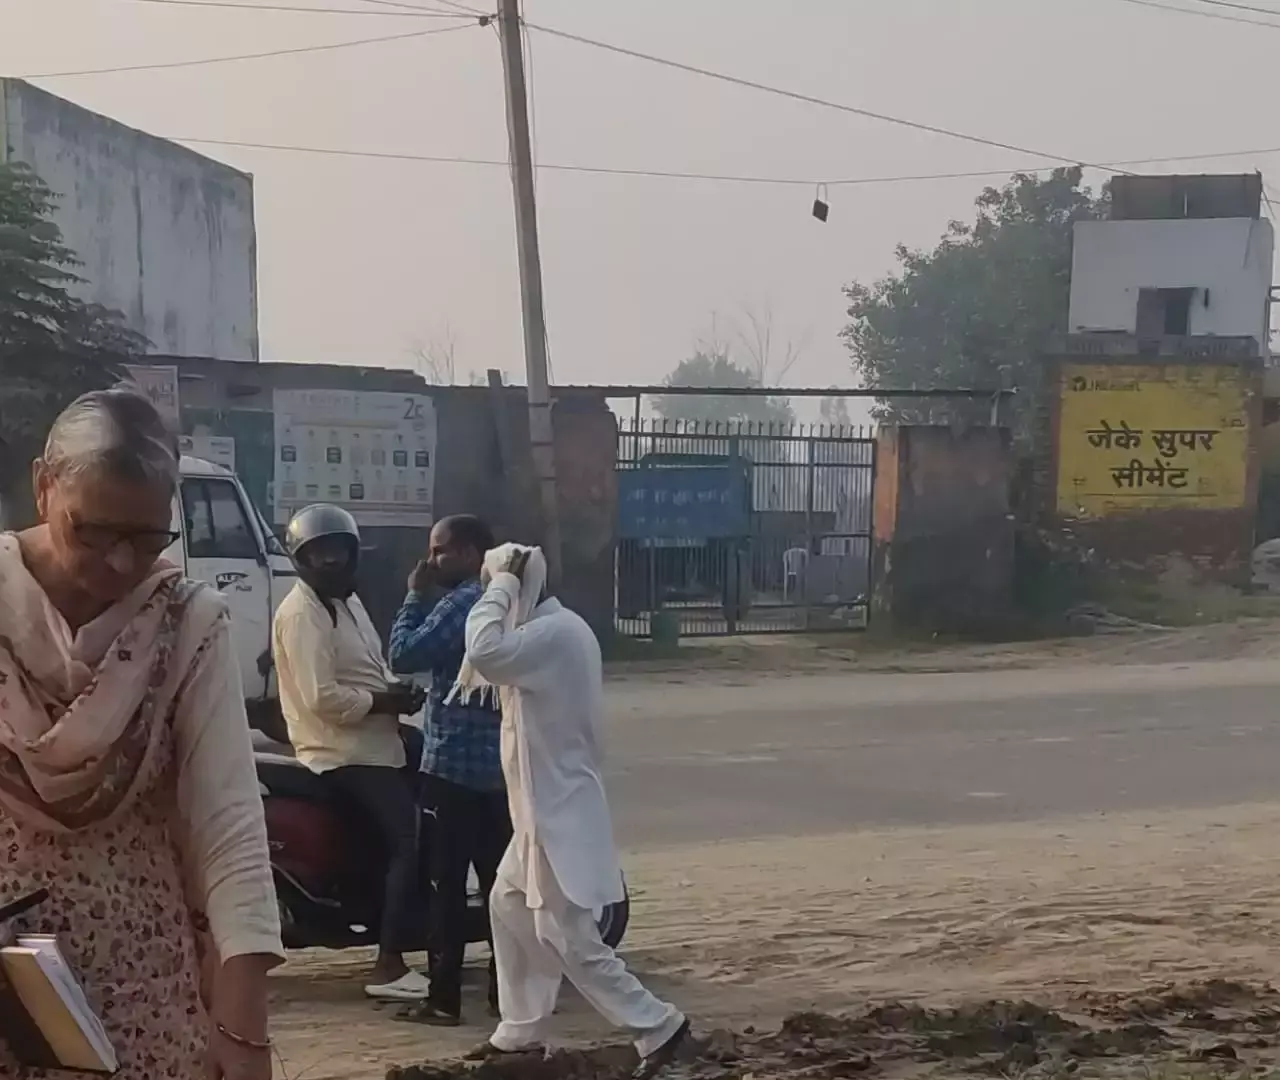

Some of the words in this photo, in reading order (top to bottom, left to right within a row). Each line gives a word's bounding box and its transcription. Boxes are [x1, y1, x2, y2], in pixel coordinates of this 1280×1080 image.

[1085, 419, 1144, 451] जेके
[1152, 427, 1220, 459] सुपर
[1108, 457, 1189, 490] सीमेंट
